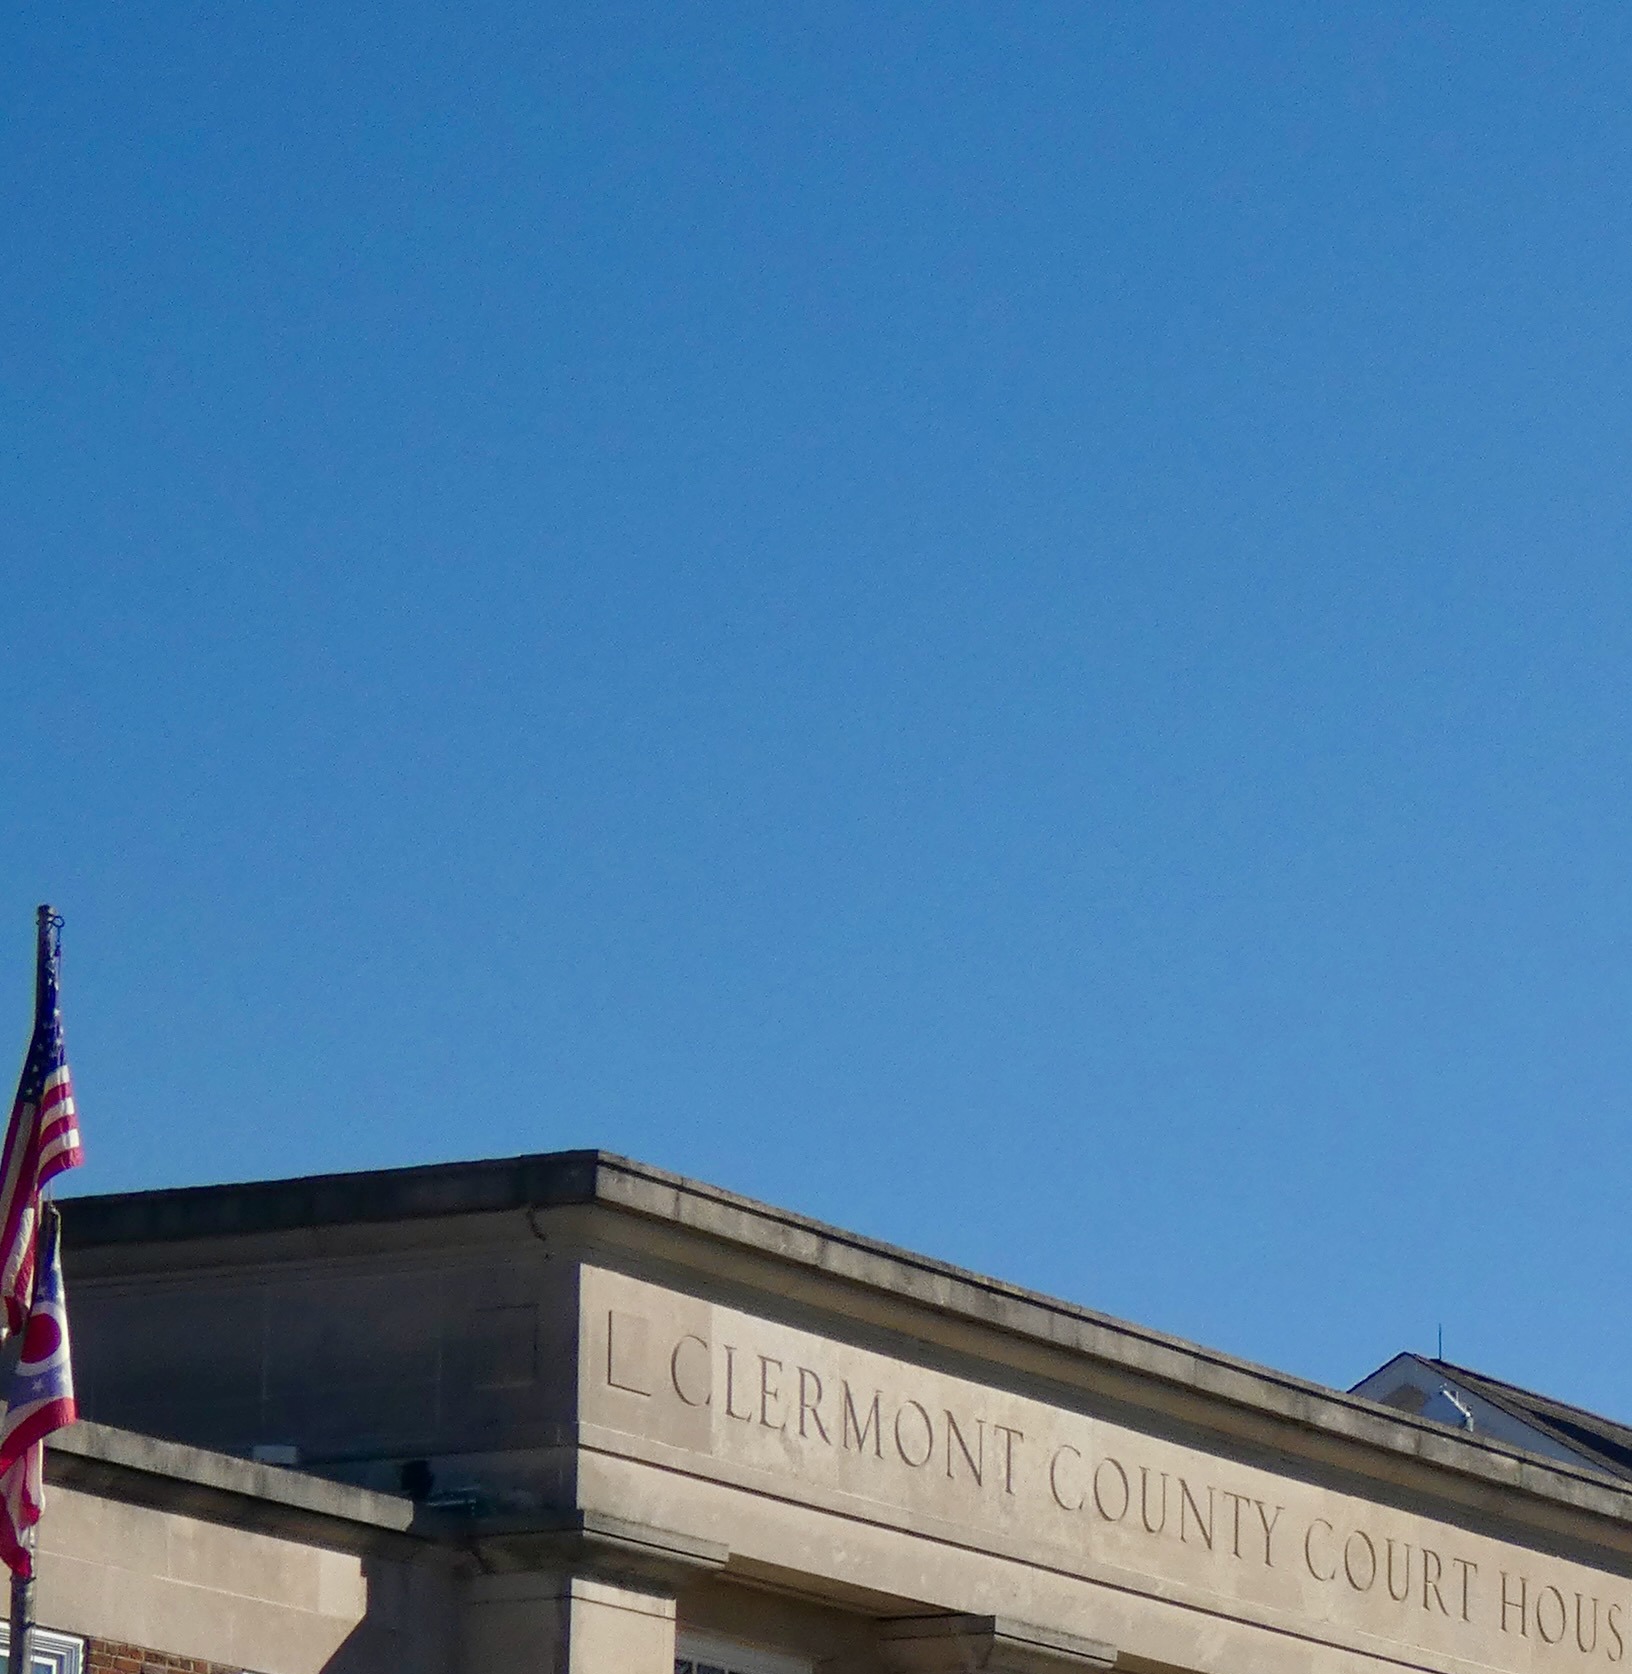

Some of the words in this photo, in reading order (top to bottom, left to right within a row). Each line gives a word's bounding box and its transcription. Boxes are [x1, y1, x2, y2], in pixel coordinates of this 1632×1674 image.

[671, 1335, 1024, 1495] CLERMONT
[1050, 1445, 1285, 1567] COUNTY
[1305, 1518, 1478, 1622] COURT
